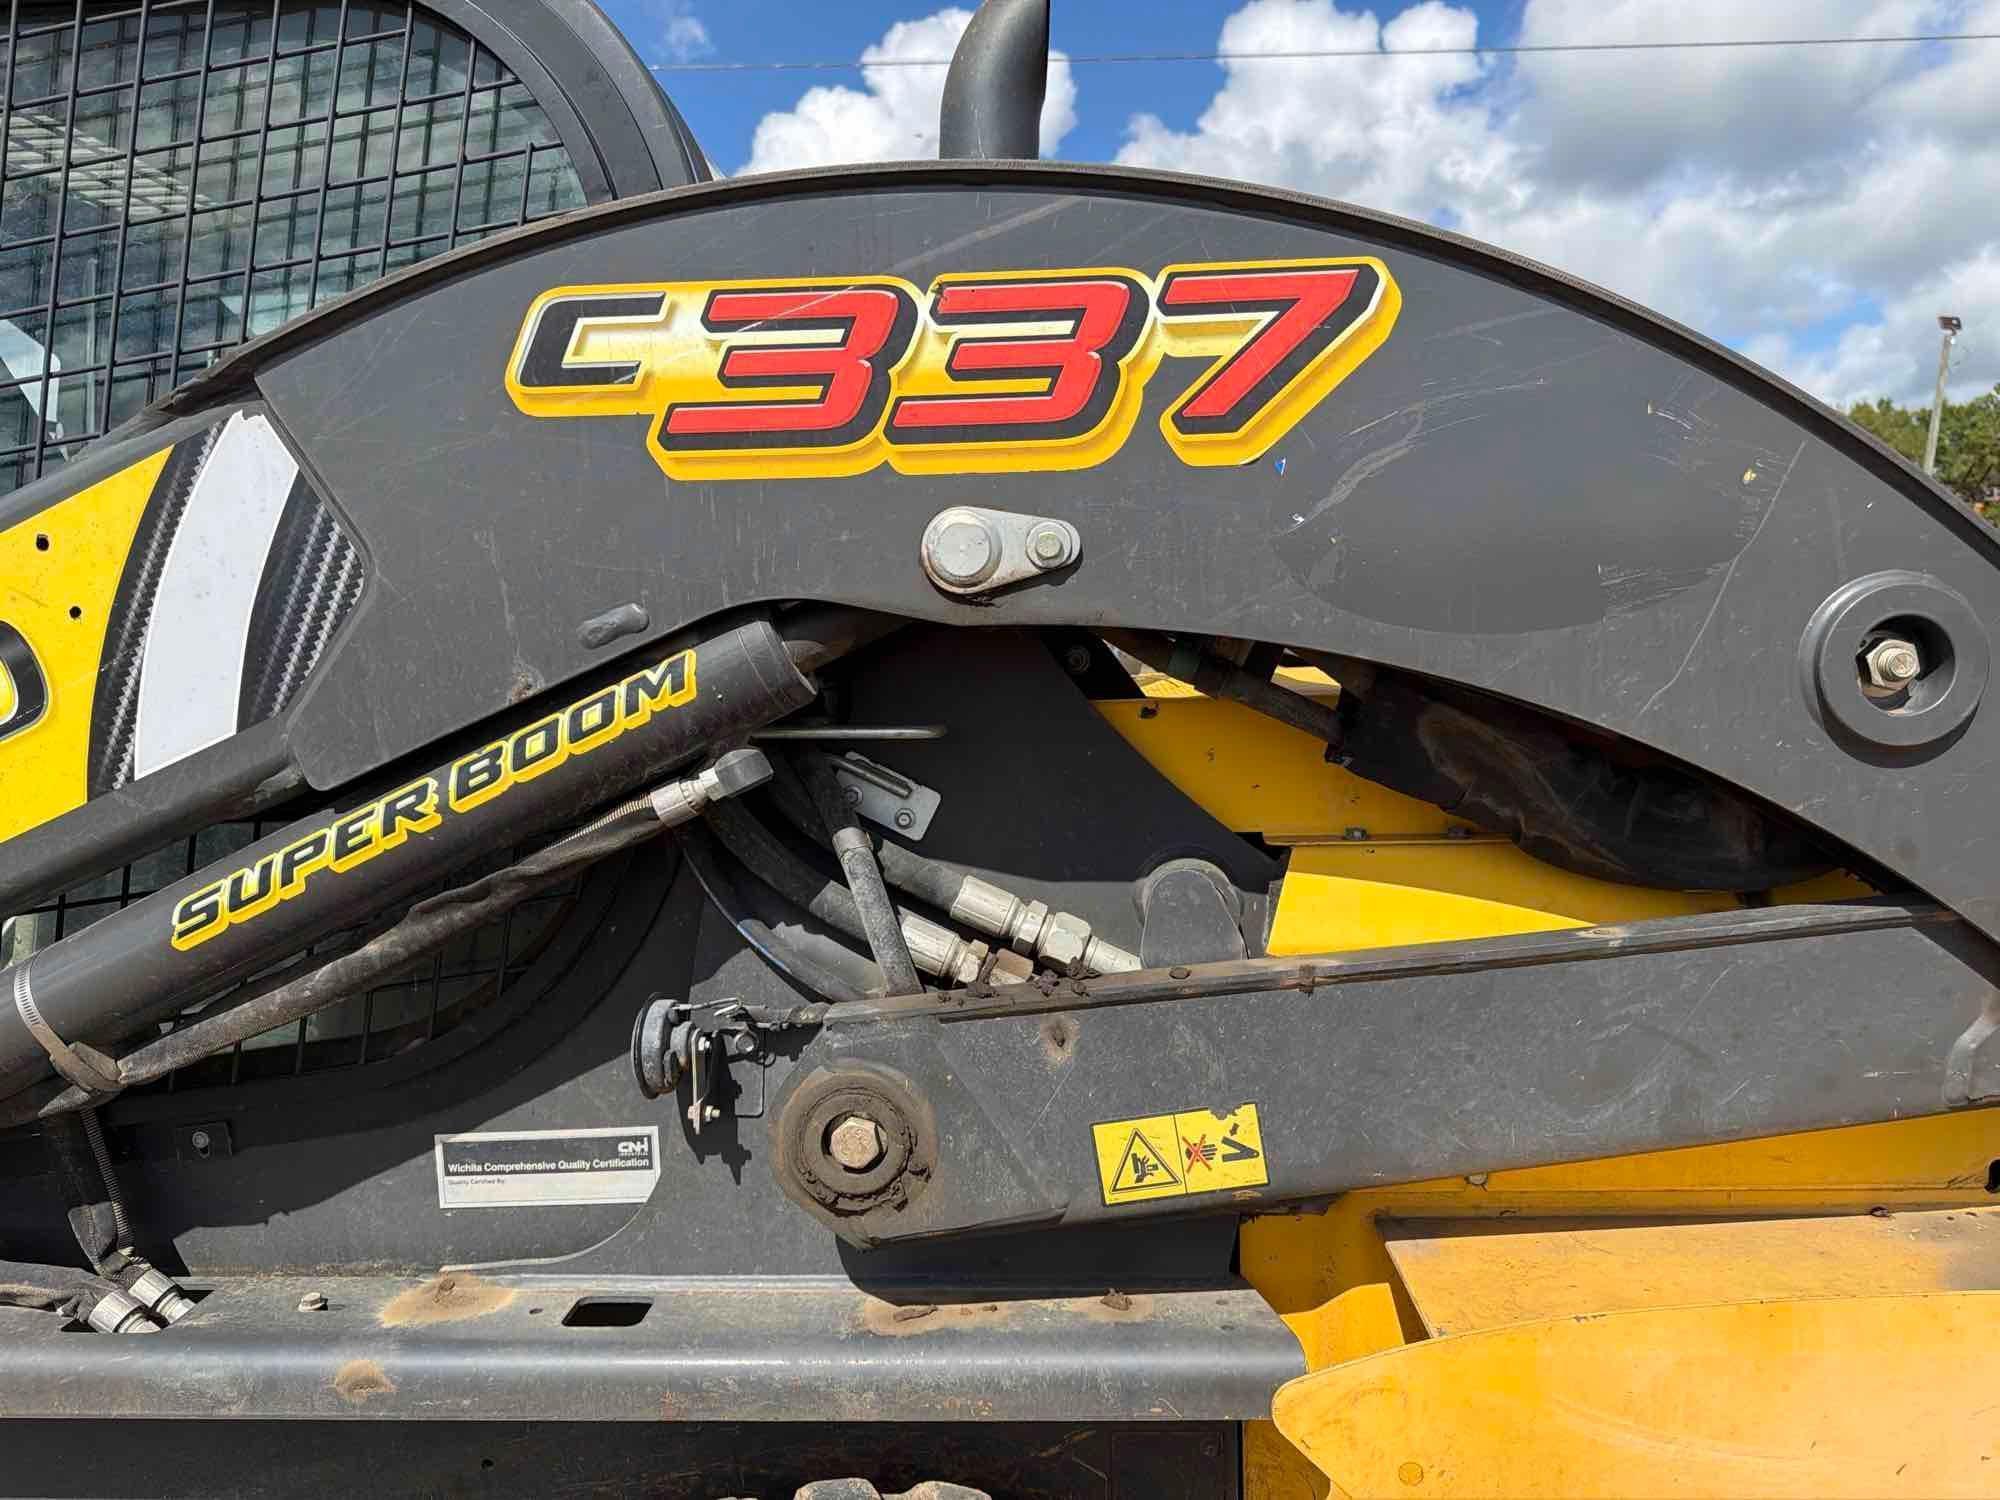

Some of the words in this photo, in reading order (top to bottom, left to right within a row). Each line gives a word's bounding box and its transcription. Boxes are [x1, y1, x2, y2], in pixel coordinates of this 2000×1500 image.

[172, 778, 441, 950] SUPER
[449, 650, 697, 813] BOOM
[618, 1137, 649, 1152] CNH
[447, 1162, 482, 1172] Wichita
[484, 1160, 556, 1173] Comprehensive
[558, 1160, 591, 1170] Quality
[592, 1157, 649, 1168] Certification
